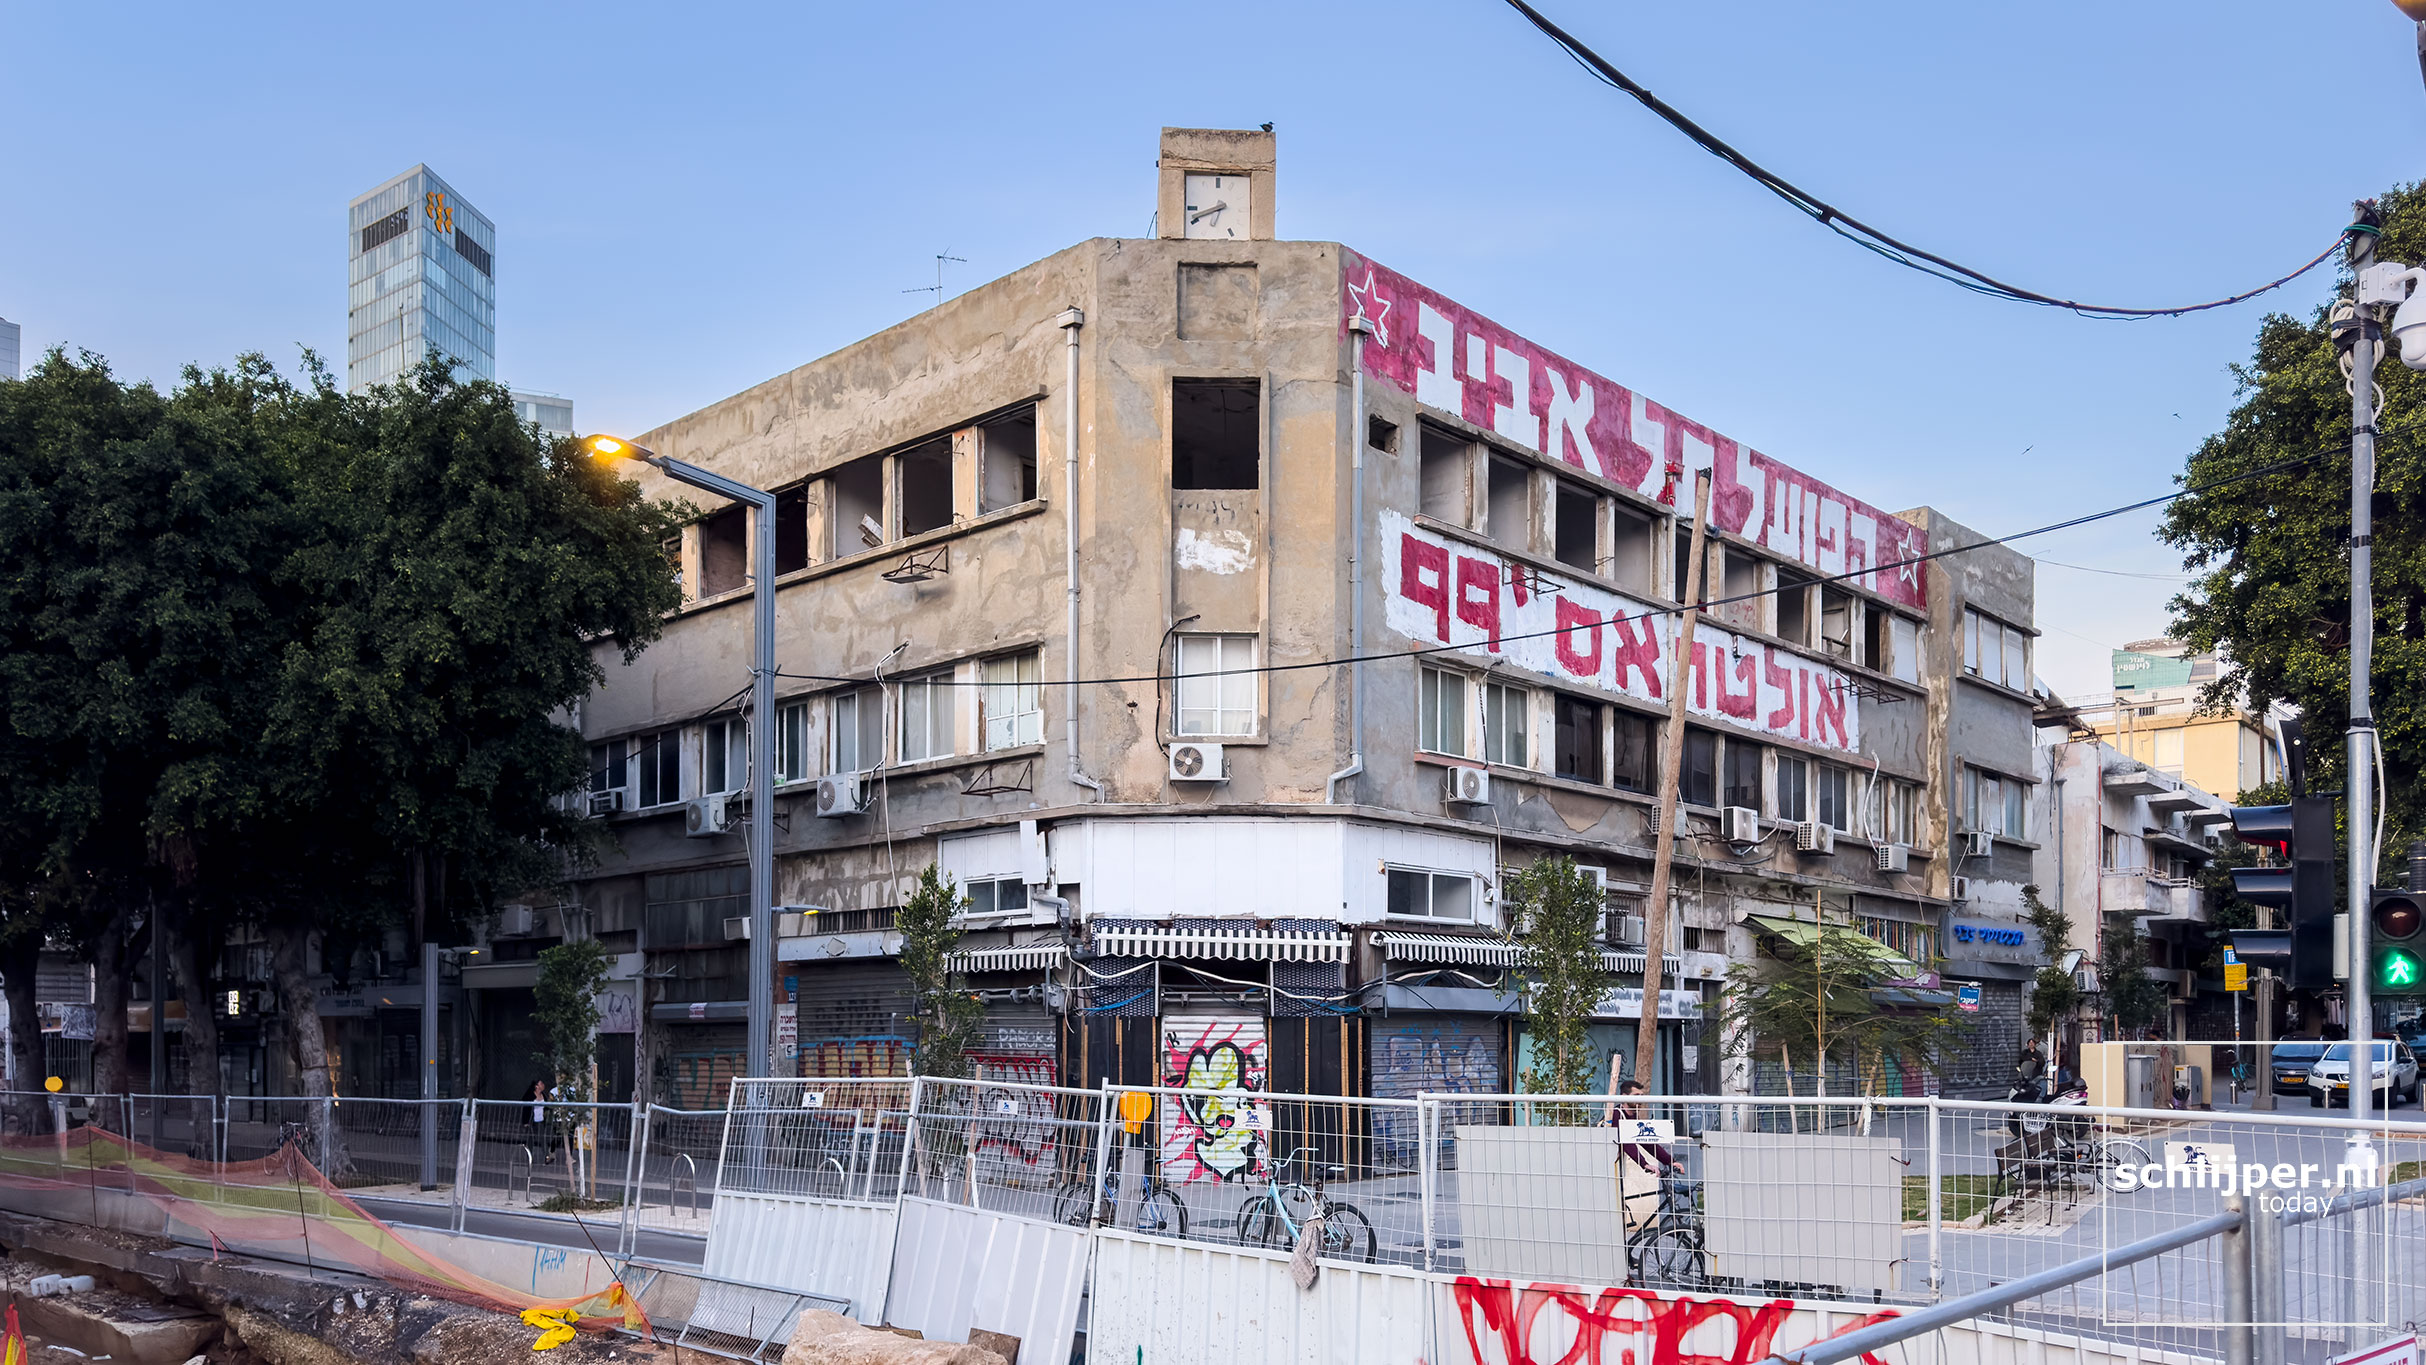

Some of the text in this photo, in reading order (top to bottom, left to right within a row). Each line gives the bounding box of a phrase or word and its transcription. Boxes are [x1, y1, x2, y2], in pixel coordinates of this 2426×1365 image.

[1417, 301, 1877, 592] הפועל תל אביב
[1556, 595, 1848, 749] אולטראס
